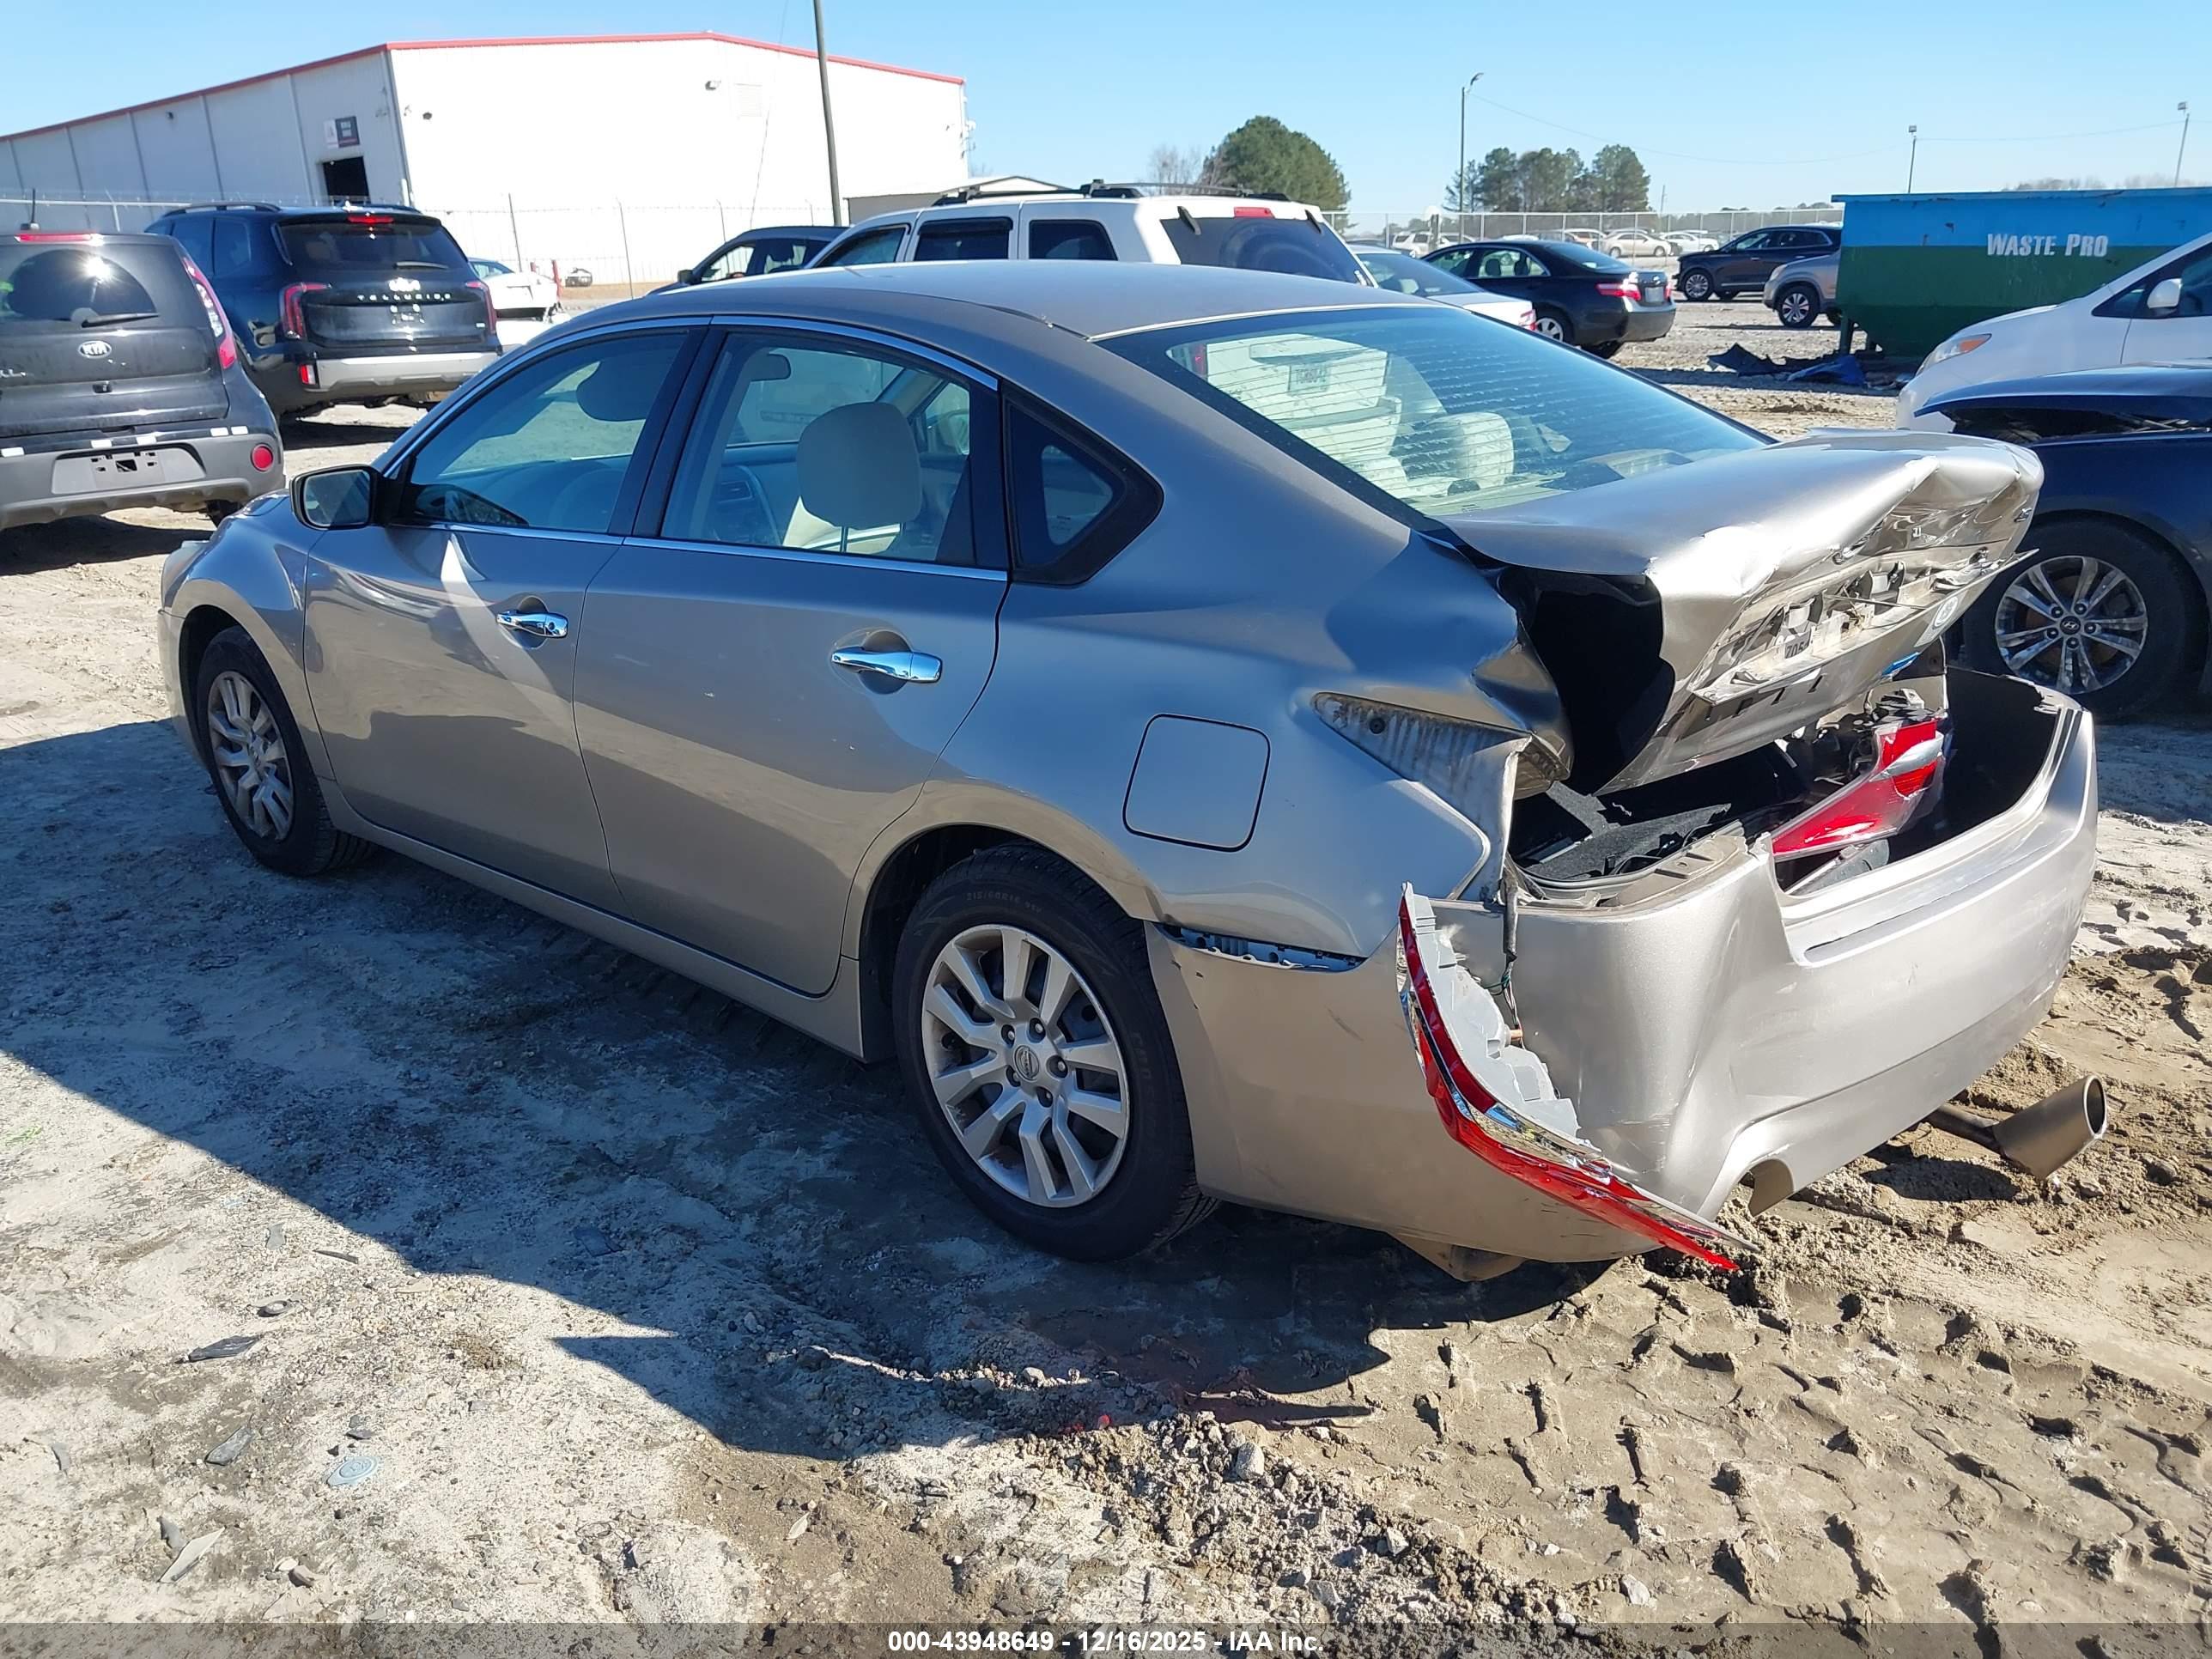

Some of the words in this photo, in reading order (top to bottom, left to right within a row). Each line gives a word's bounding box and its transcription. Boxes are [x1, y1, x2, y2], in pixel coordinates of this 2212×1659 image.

[1987, 234, 2057, 256] WASTE
[2064, 234, 2109, 257] PRO
[81, 343, 109, 356] KIA
